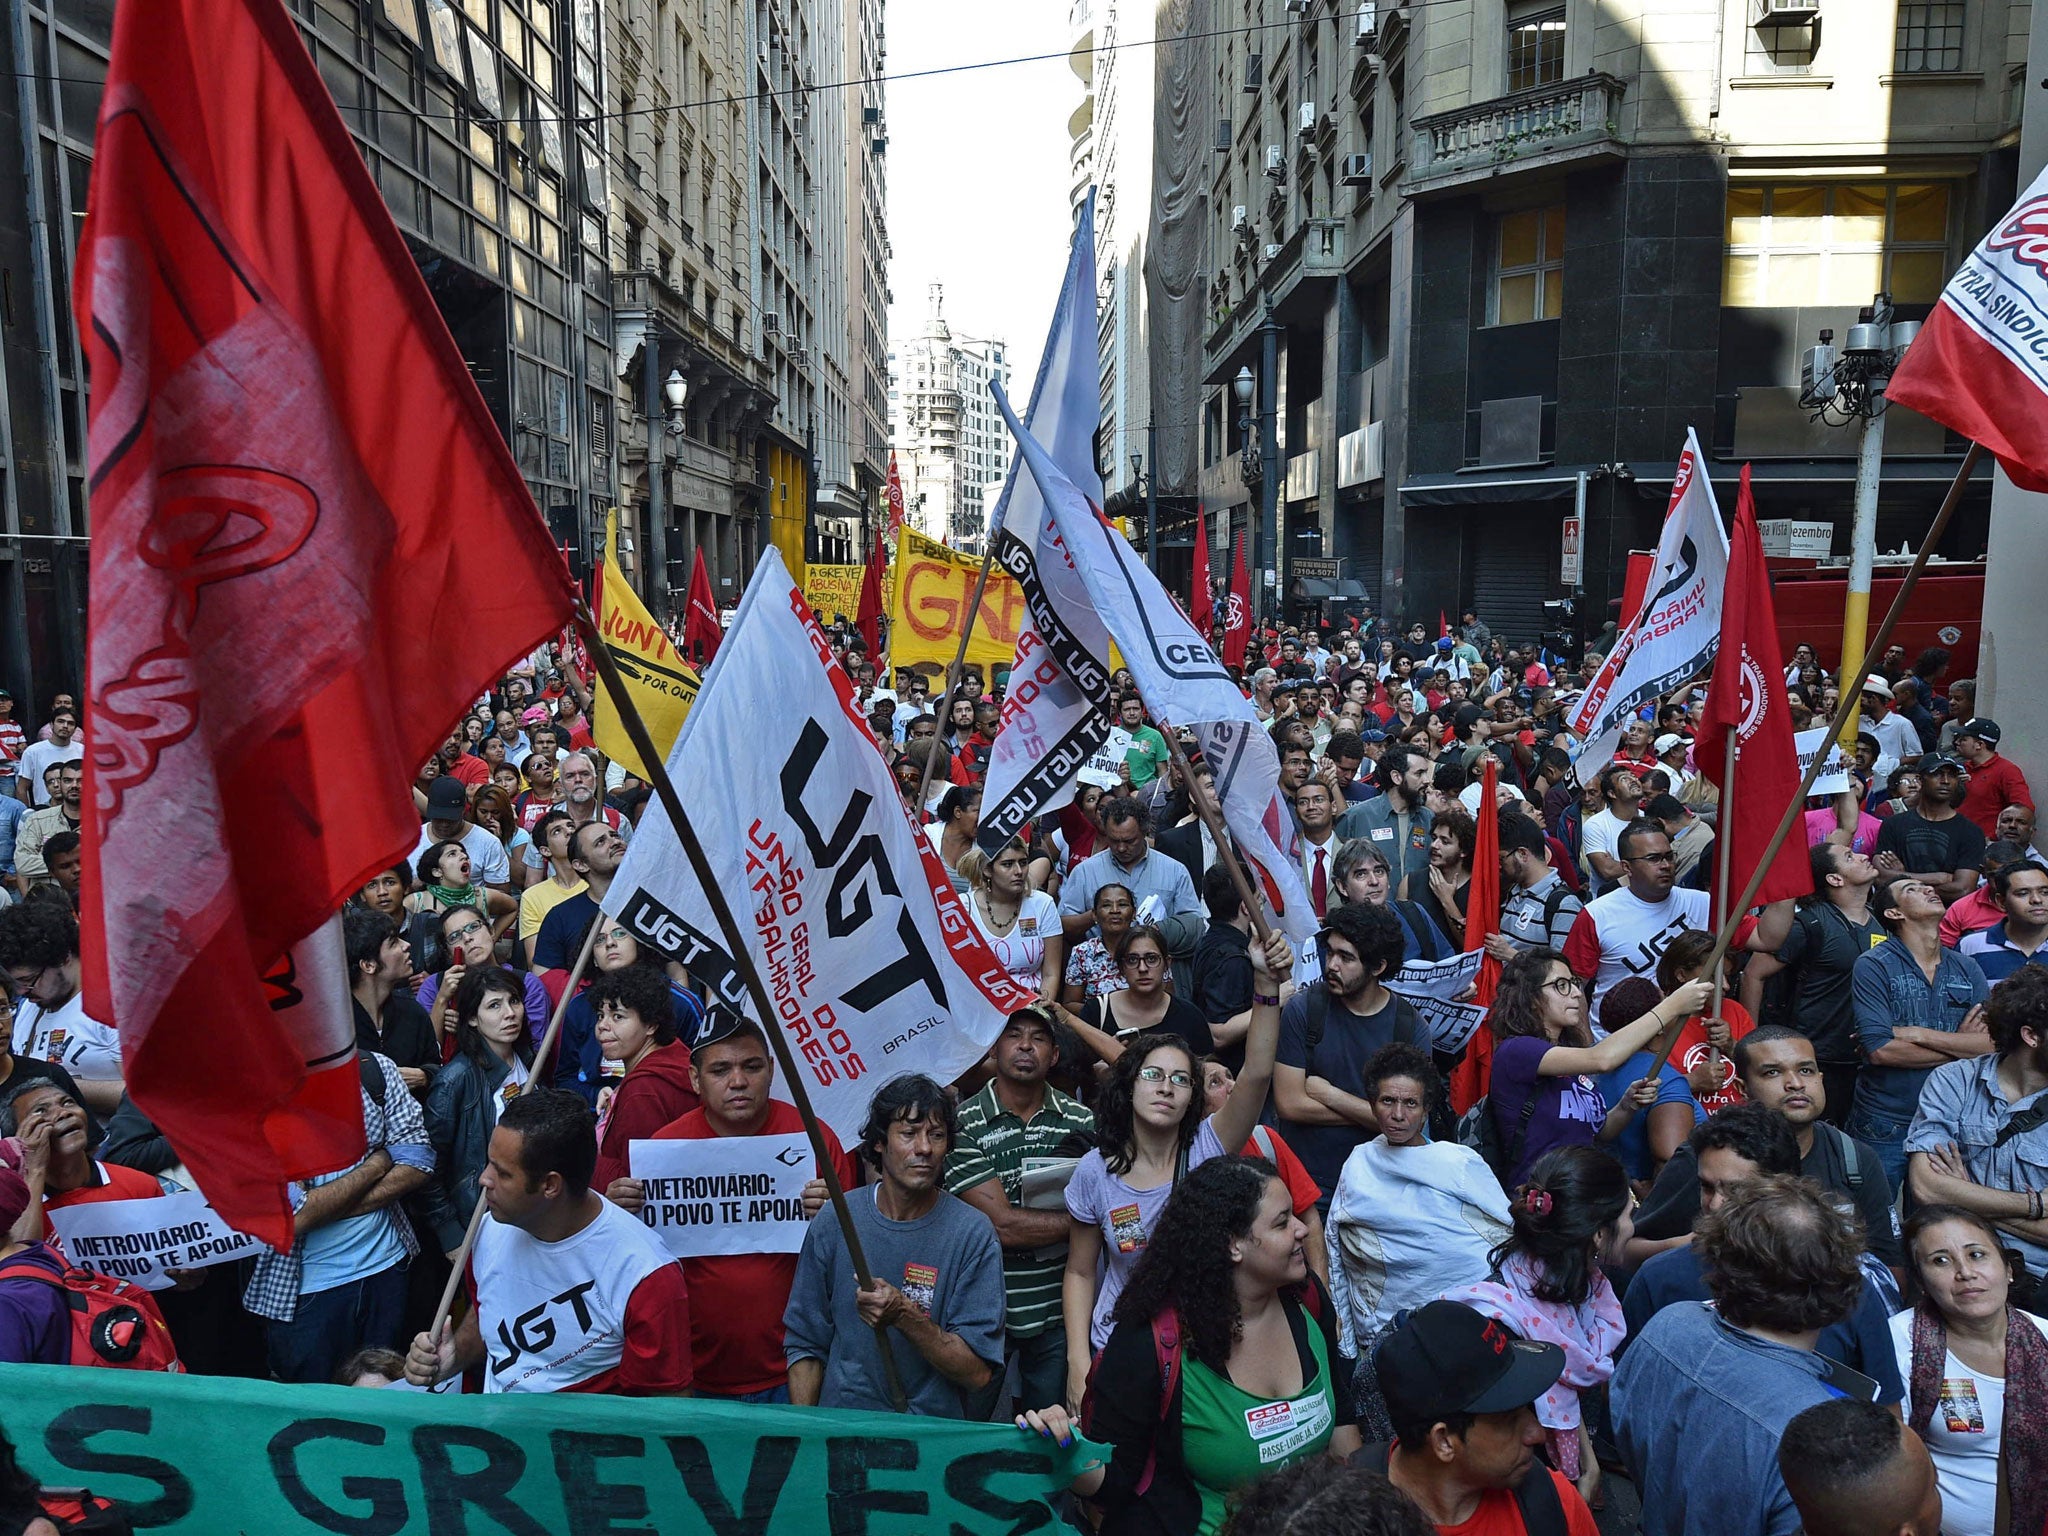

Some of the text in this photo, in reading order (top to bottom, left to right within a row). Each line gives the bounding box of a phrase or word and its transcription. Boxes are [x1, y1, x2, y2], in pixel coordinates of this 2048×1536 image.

[1772, 522, 1788, 536] Vista
[1791, 526, 1831, 539] ezembro
[819, 567, 861, 579] GREVE
[1001, 540, 1037, 587] UGT
[1030, 591, 1069, 648] UGT
[643, 673, 667, 695] POR
[671, 685, 697, 704] OUT
[1095, 758, 1119, 774] APOIA
[780, 716, 951, 1014] UGT
[633, 902, 713, 966] UGT
[934, 884, 981, 951] UGT
[979, 968, 1029, 1009] UGT
[1394, 963, 1460, 981] TROVIÁRIOS
[1405, 996, 1457, 1017] ROVIÁRIOS
[812, 1002, 868, 1081] DOS
[882, 1015, 945, 1056] BRASIL
[643, 1204, 656, 1228] O
[663, 1202, 714, 1227] POVO
[719, 1200, 742, 1224] TE
[155, 1252, 182, 1267] TE
[188, 1232, 254, 1266] APOIA!
[1251, 1404, 1288, 1420] CSP
[1261, 1432, 1306, 1459] PASSE-LIVRE
[267, 1417, 1054, 1536] GREVES
